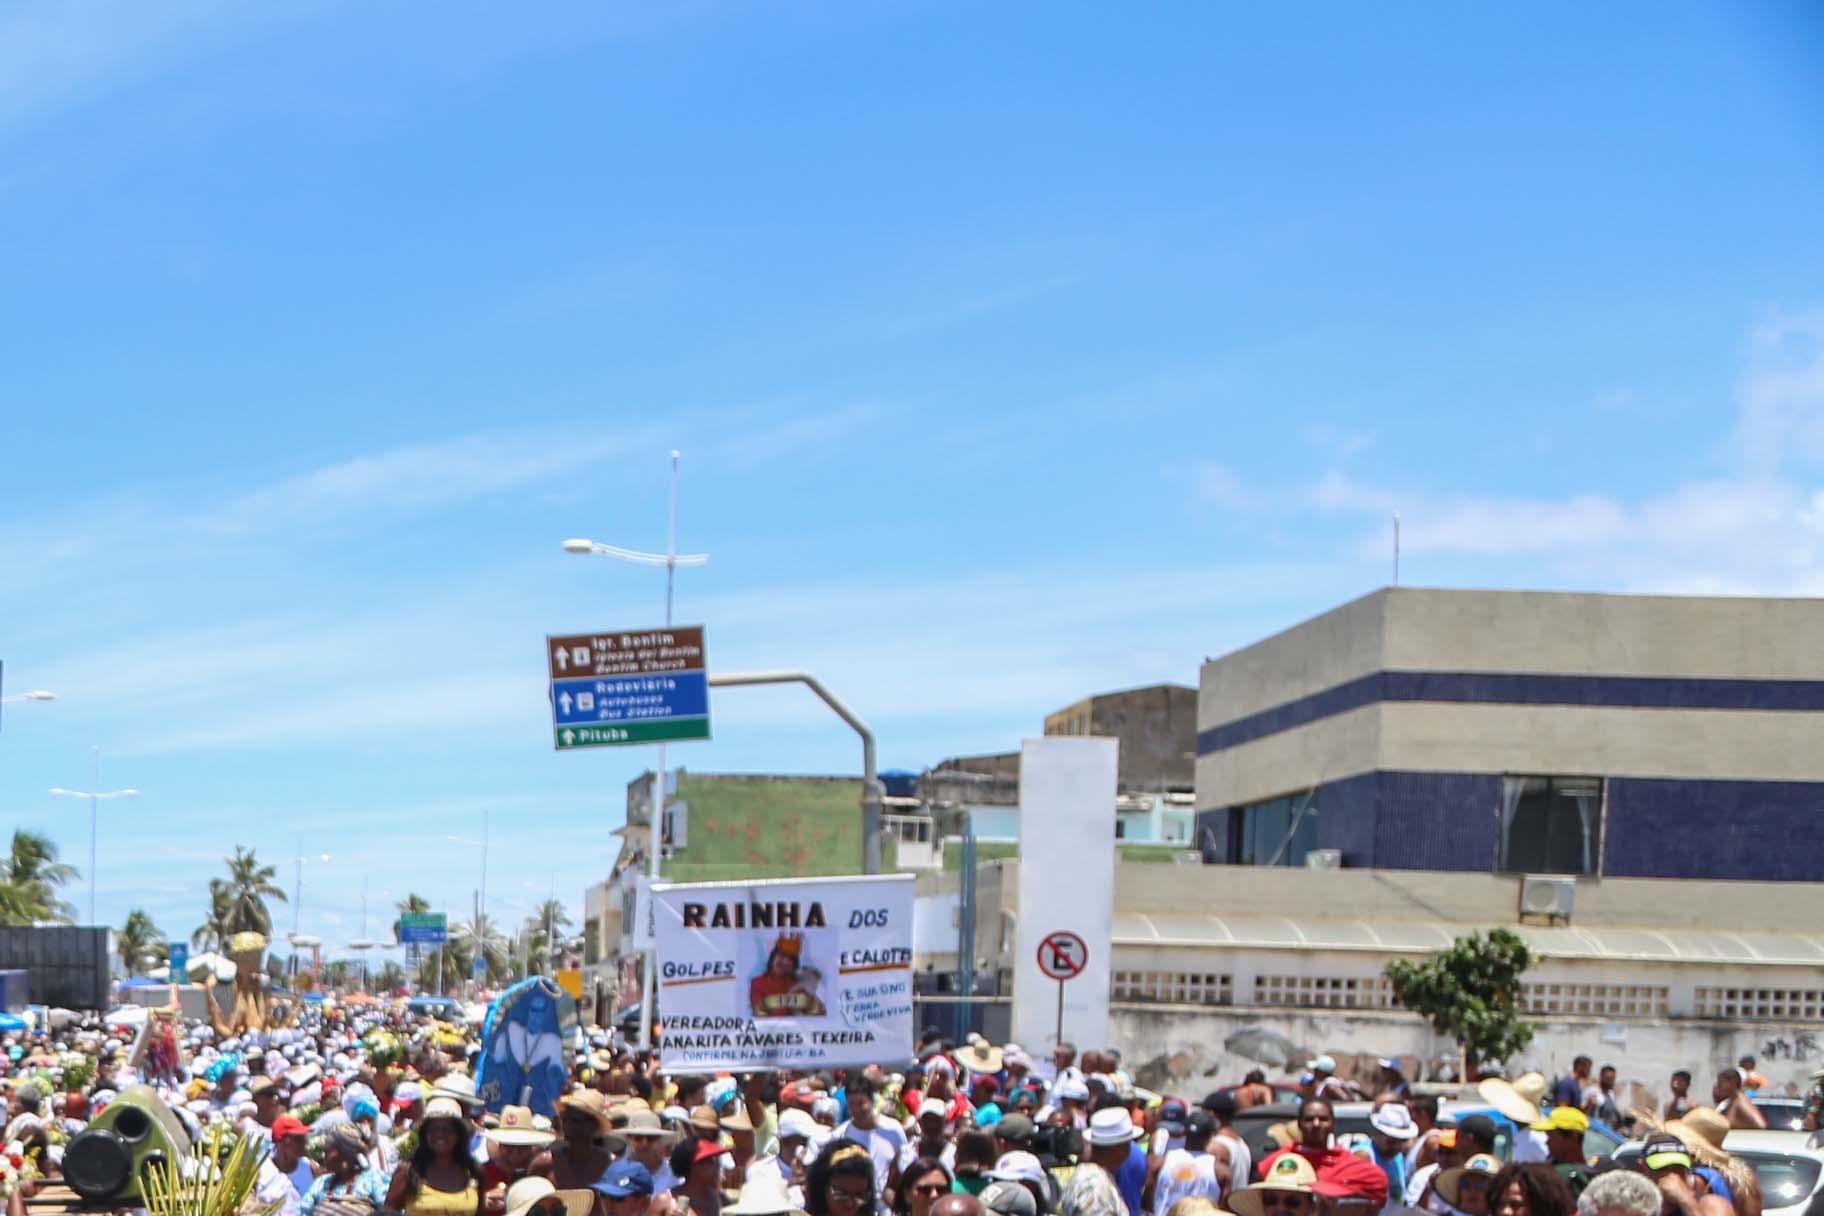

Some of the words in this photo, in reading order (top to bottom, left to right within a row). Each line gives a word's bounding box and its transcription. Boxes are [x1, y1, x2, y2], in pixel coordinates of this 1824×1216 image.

[622, 633, 674, 647] Bonfim
[579, 728, 629, 742] Pituba
[683, 902, 825, 929] RAINHA
[848, 909, 889, 929] DOS
[663, 961, 735, 978] GOLPES
[662, 1015, 757, 1034] VEREADORA
[663, 1033, 732, 1049] ANARITA
[735, 1031, 804, 1048] TAVARES
[812, 1031, 875, 1045] TEXEIRA
